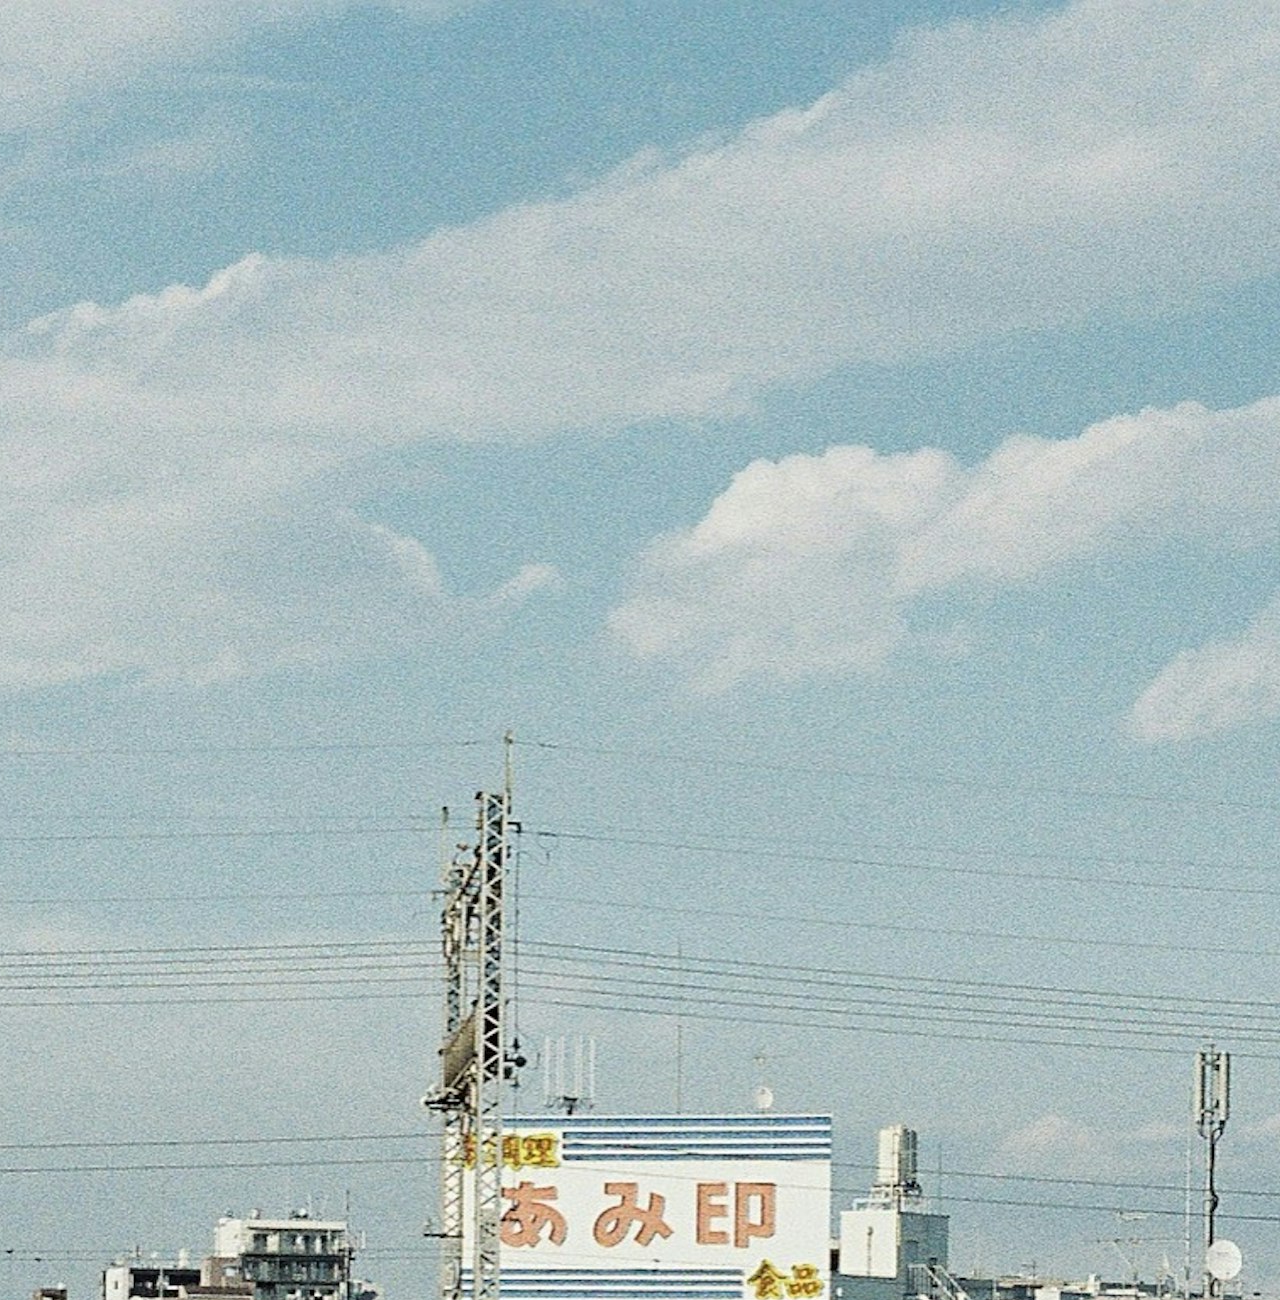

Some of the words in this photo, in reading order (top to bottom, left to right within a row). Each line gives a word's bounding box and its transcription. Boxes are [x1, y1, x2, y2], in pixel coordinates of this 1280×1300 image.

[499, 1181, 777, 1249] あみ印
[749, 1260, 822, 1299] 食品
